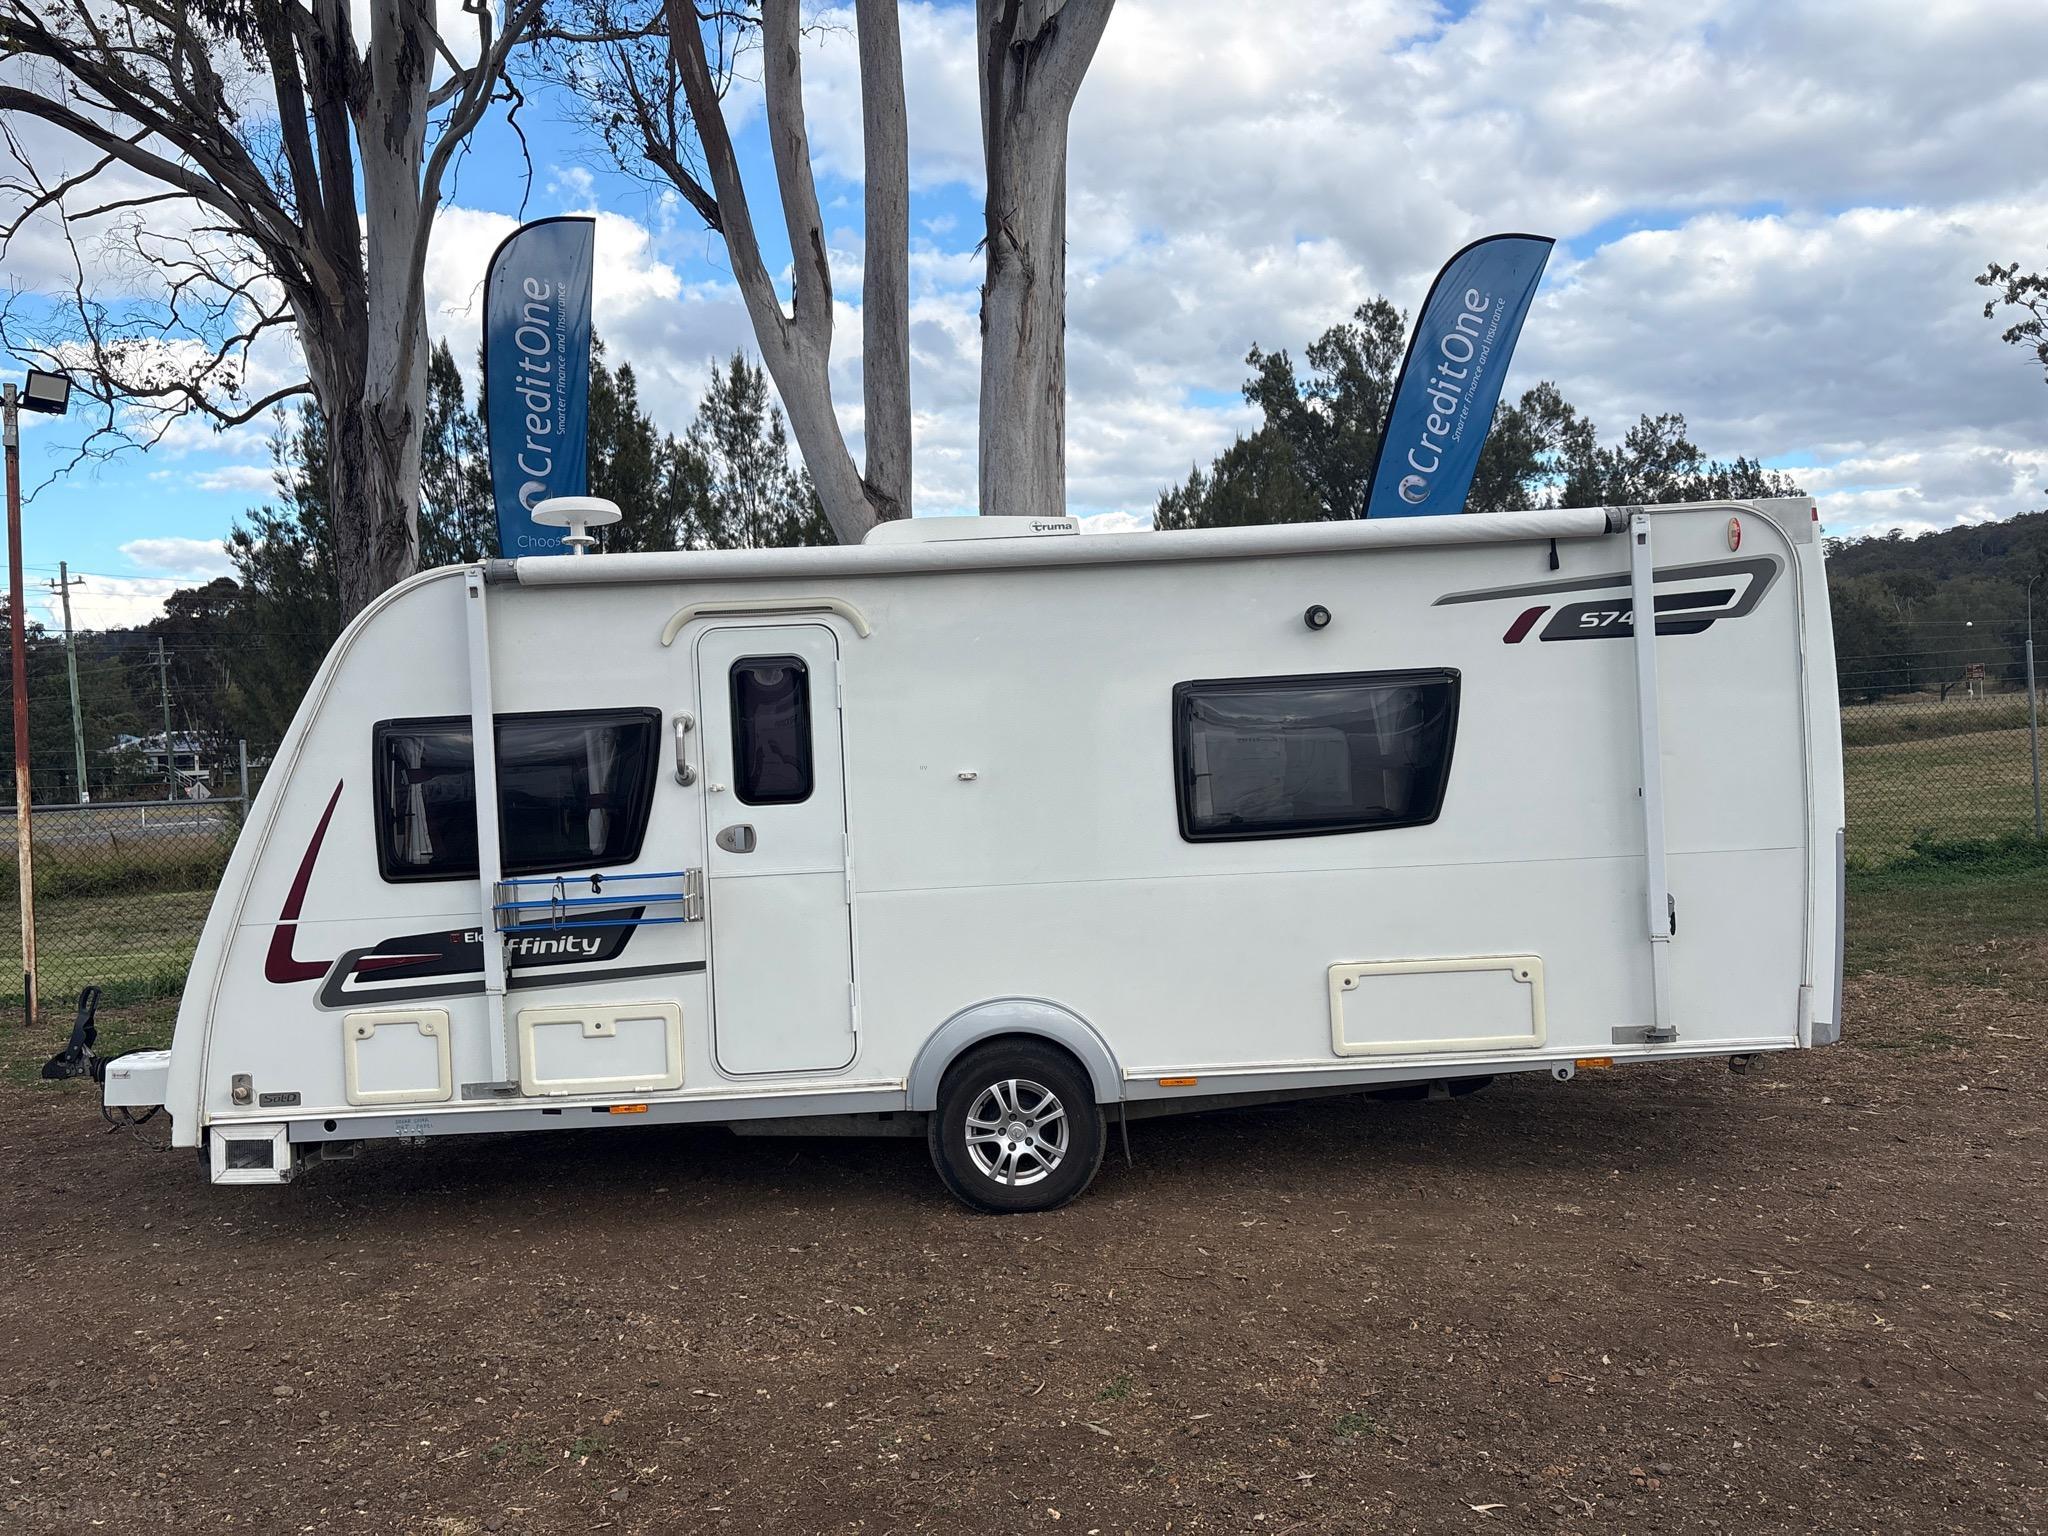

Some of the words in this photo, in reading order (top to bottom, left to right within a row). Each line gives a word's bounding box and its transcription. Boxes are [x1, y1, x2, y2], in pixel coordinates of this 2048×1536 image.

[556, 282, 566, 331] Insurance
[1483, 297, 1506, 345] Insurance
[557, 334, 566, 353] and
[1479, 345, 1490, 365] and
[515, 277, 551, 477] CreditOne
[556, 356, 566, 394] Finance
[1408, 288, 1490, 474] CreditOne
[1464, 366, 1483, 404] Finance
[556, 397, 566, 435] Smarter
[1452, 405, 1470, 442] Smarter
[1032, 522, 1072, 531] truma
[504, 936, 601, 955] ffinity
